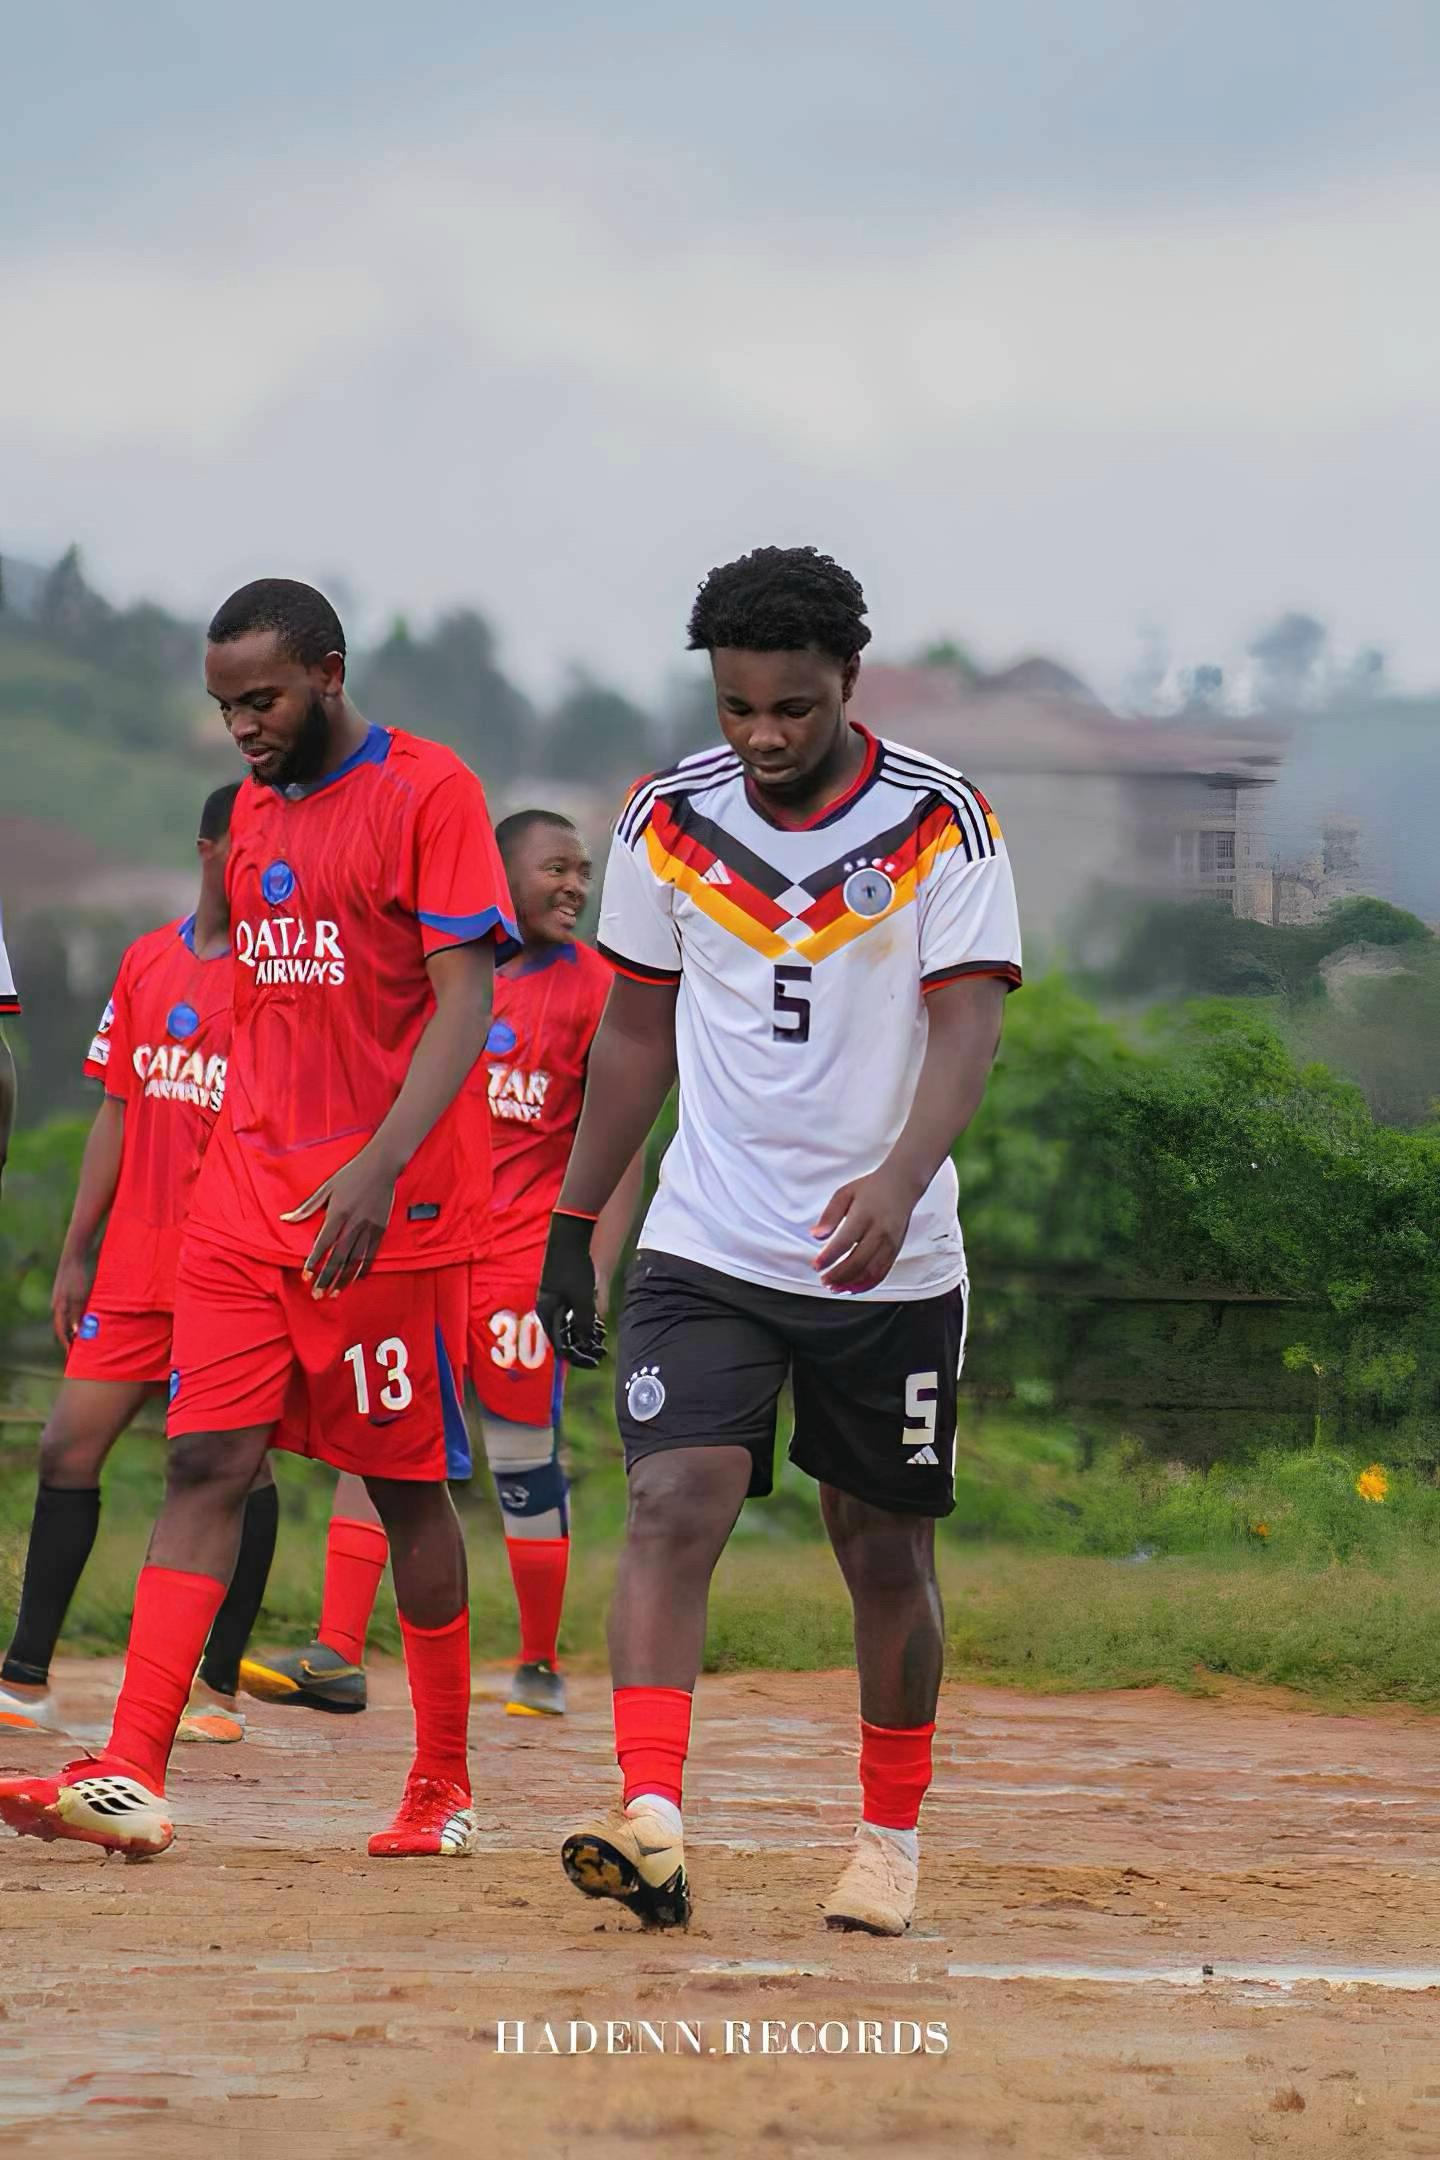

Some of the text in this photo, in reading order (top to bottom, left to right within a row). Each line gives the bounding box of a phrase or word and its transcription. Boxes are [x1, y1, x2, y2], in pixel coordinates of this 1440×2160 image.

[236, 917, 344, 967] QATAR
[255, 959, 345, 985] AIRWAYS
[772, 964, 812, 1043] 5
[487, 1062, 549, 1105] TAR
[489, 1309, 547, 1369] 30
[344, 1336, 413, 1414] 13
[902, 1371, 938, 1445] 5
